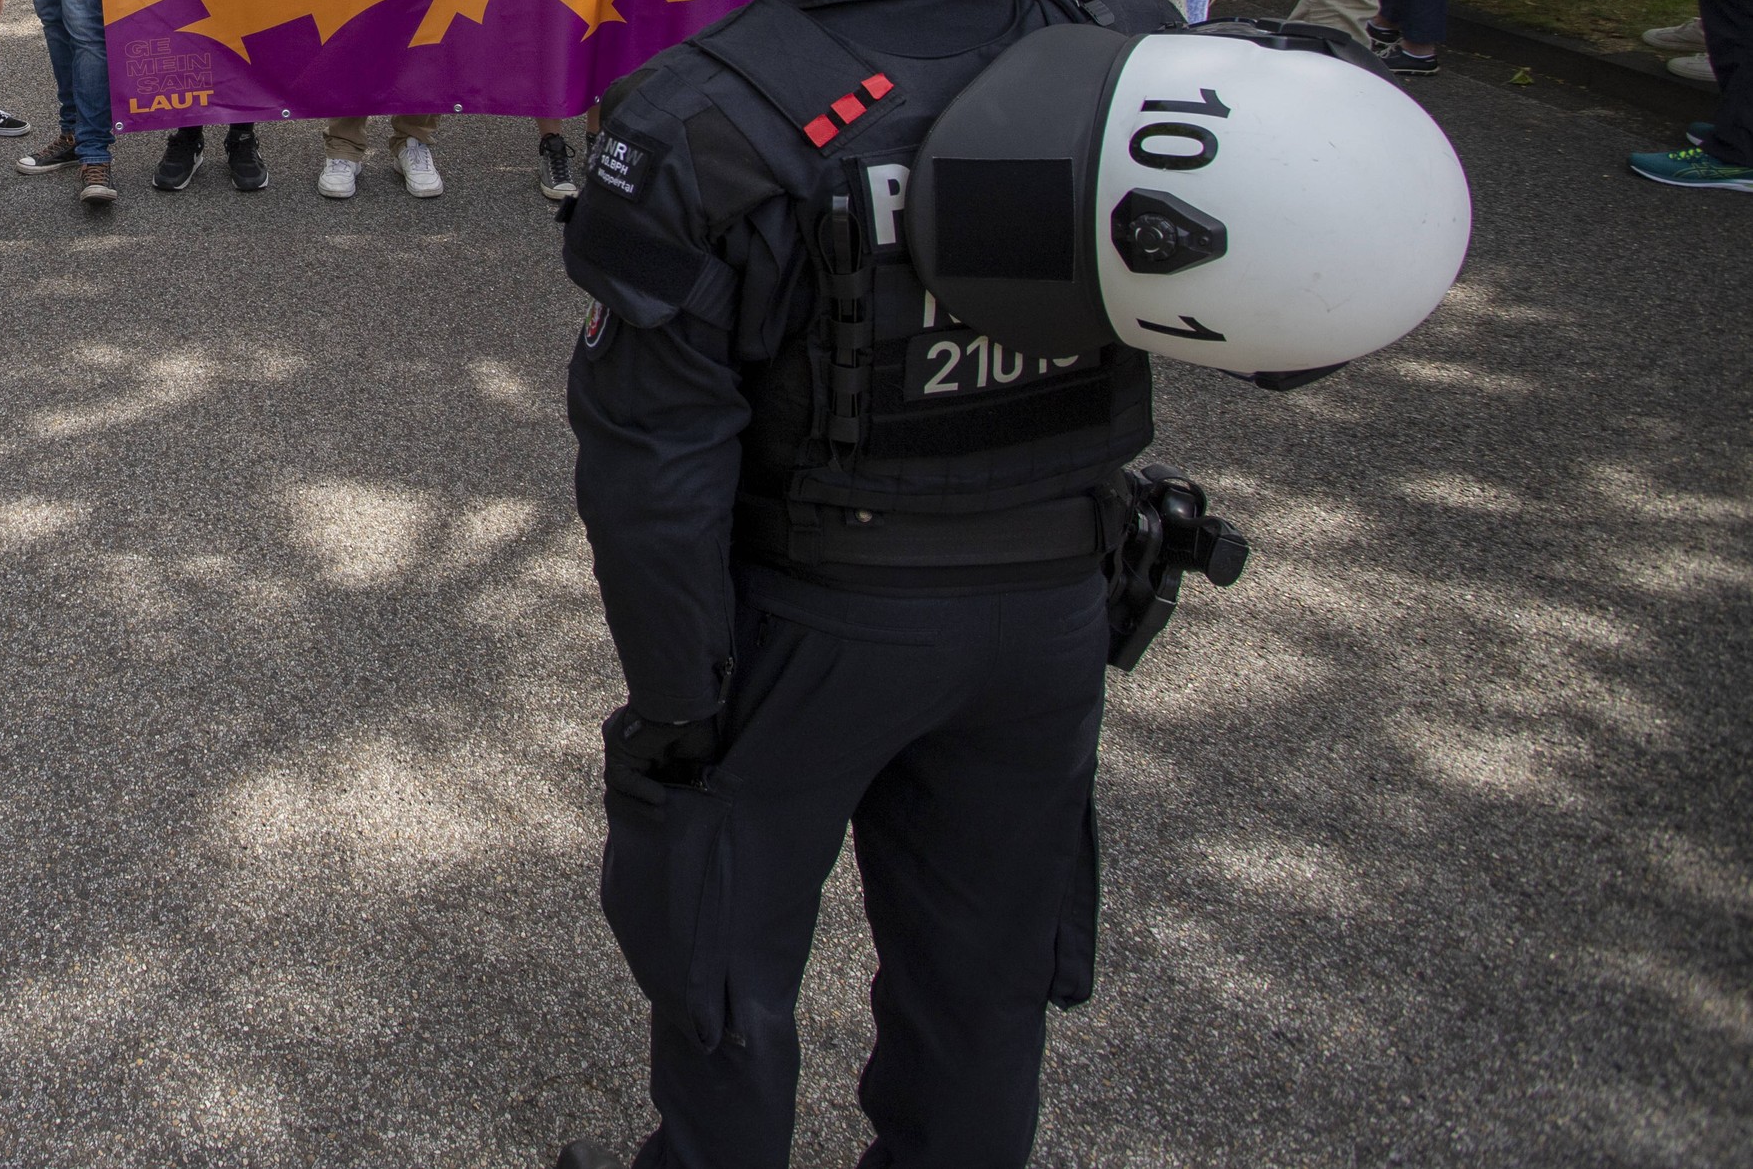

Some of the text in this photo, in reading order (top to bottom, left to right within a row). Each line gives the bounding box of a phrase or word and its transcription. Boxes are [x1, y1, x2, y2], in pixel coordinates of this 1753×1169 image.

[125, 38, 171, 58] GE
[126, 53, 212, 77] MEIN
[137, 71, 213, 95] SAM
[129, 89, 215, 114] LAUT
[1129, 88, 1231, 171] 10
[604, 137, 643, 166] NRW
[1136, 315, 1227, 342] 1
